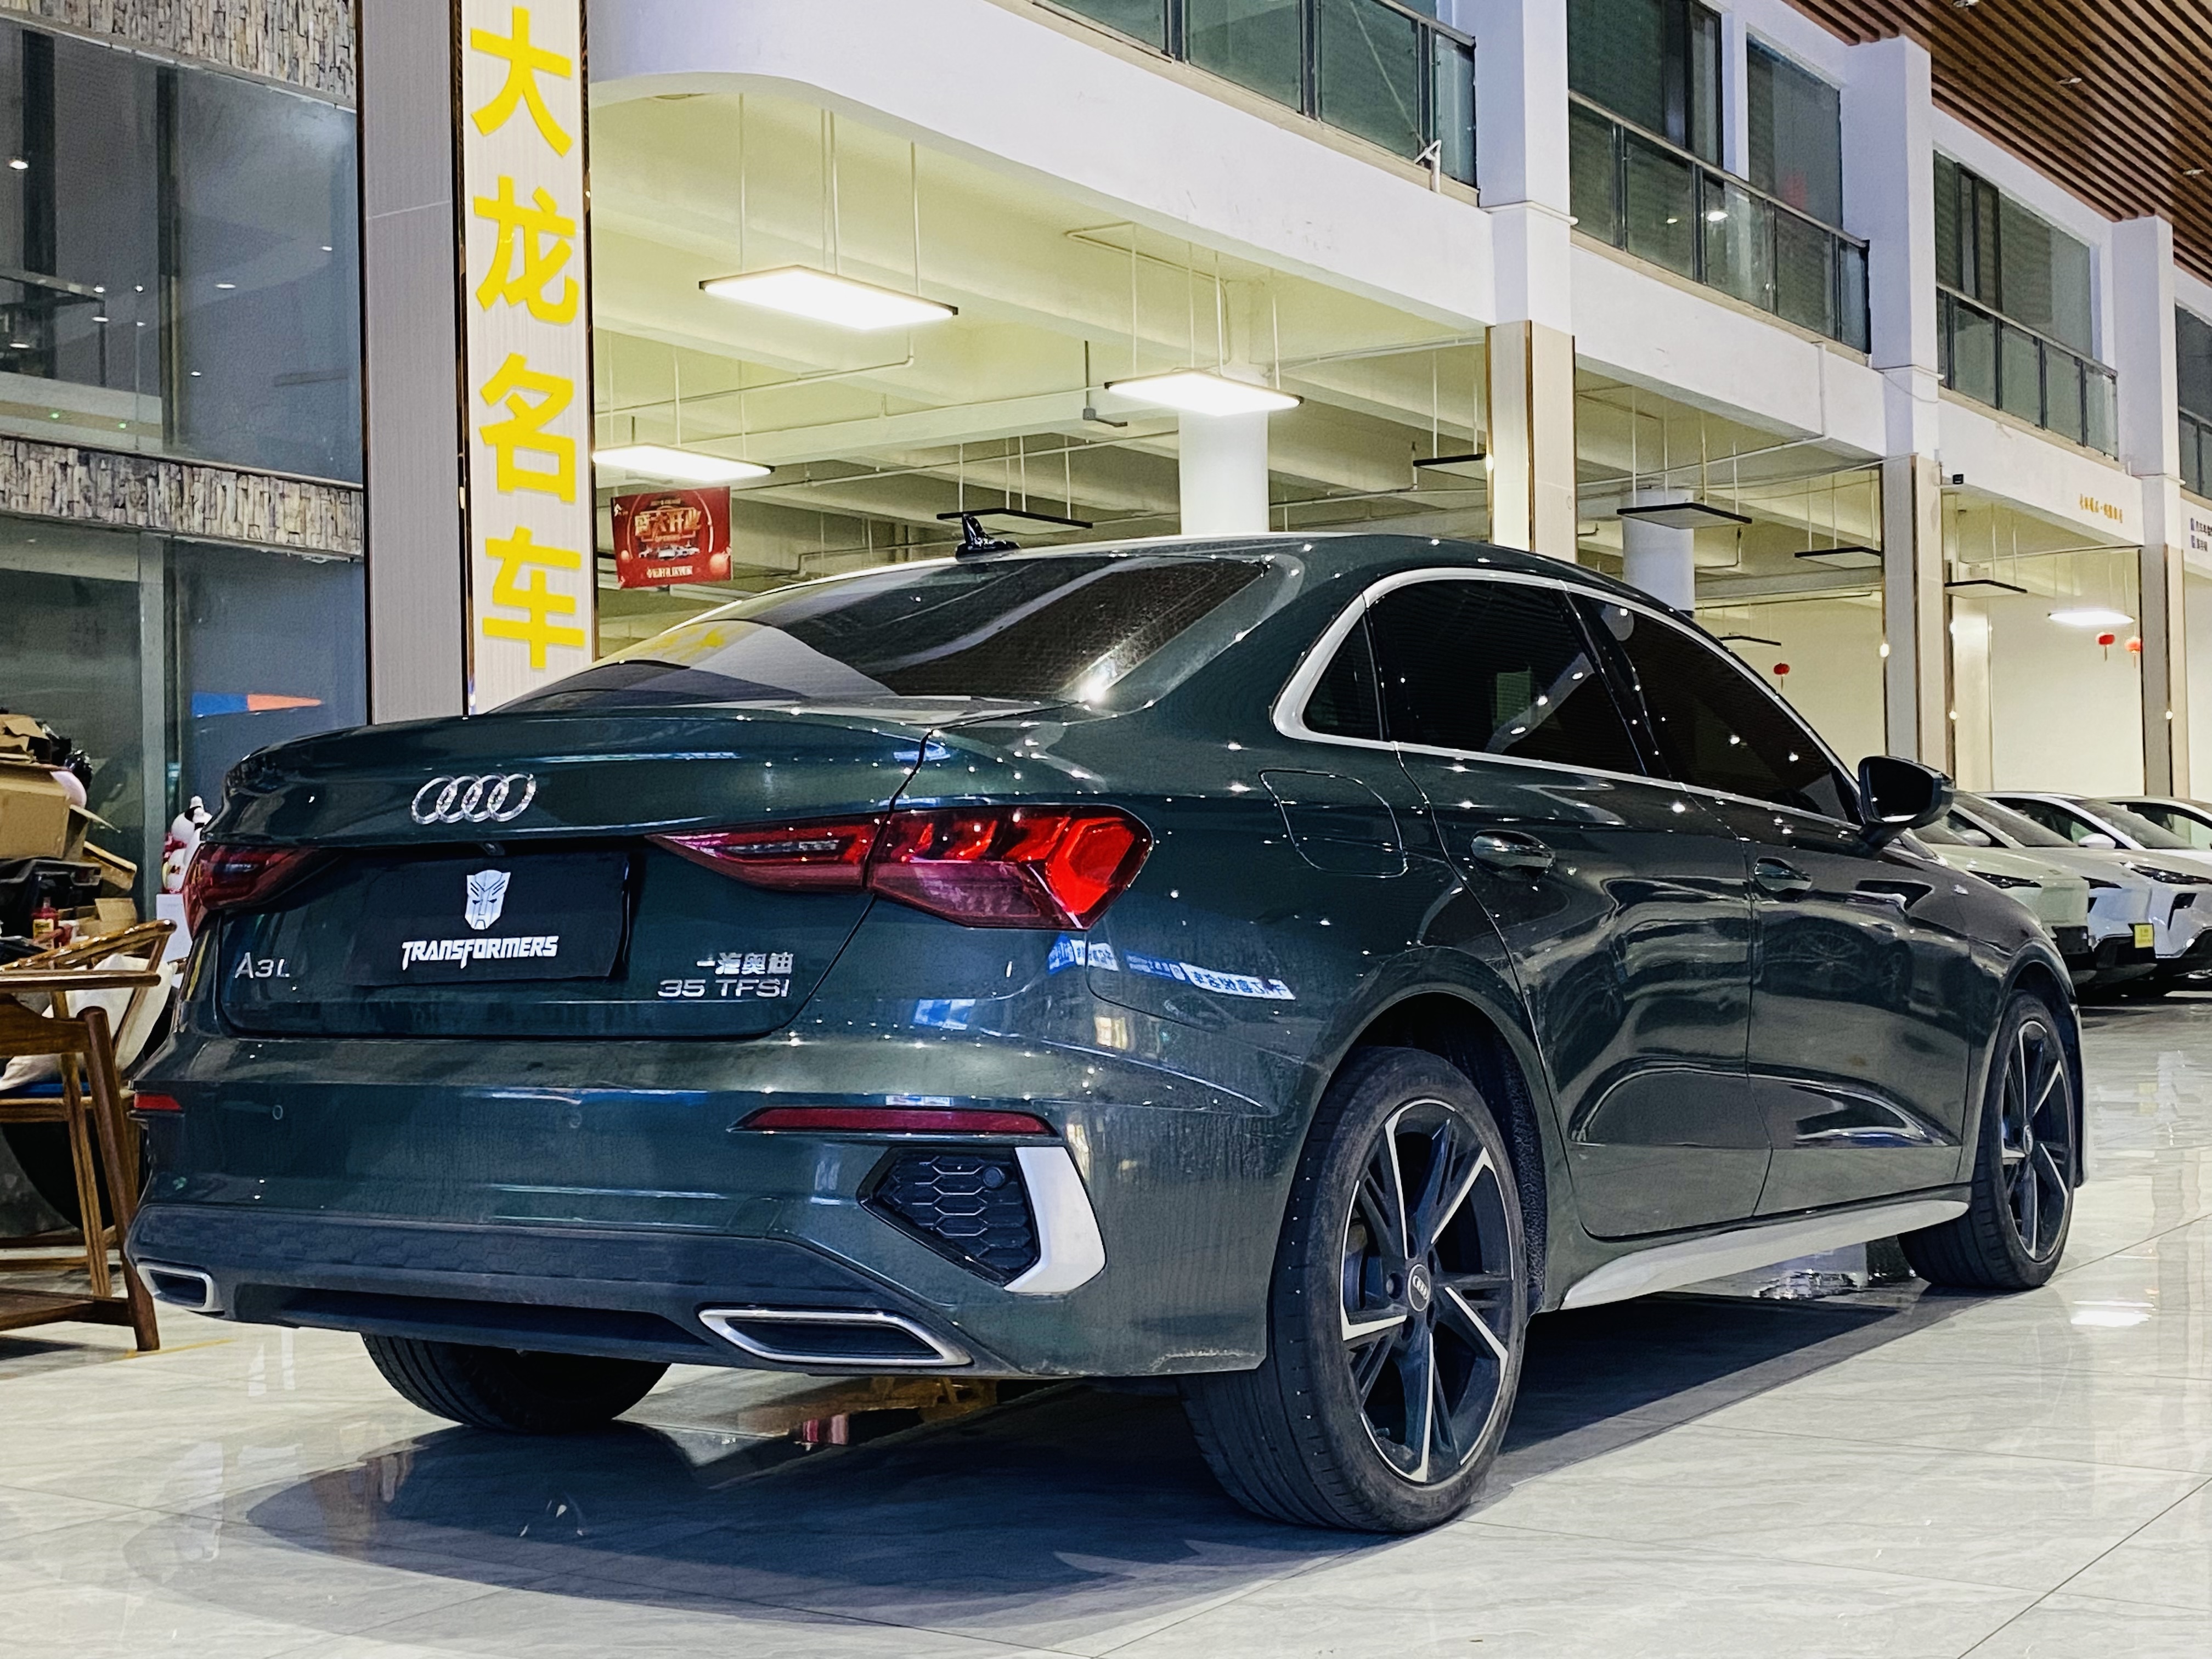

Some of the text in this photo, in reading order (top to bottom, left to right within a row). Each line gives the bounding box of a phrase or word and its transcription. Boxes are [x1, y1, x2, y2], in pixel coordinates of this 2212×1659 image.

[471, 7, 584, 668] 大龙名车
[635, 509, 702, 538] 盛大开业
[235, 952, 290, 978] A3L
[402, 935, 558, 970] TRANSFORMERS
[697, 952, 793, 974] 一汽奥迪
[657, 979, 789, 997] 35 TFSI
